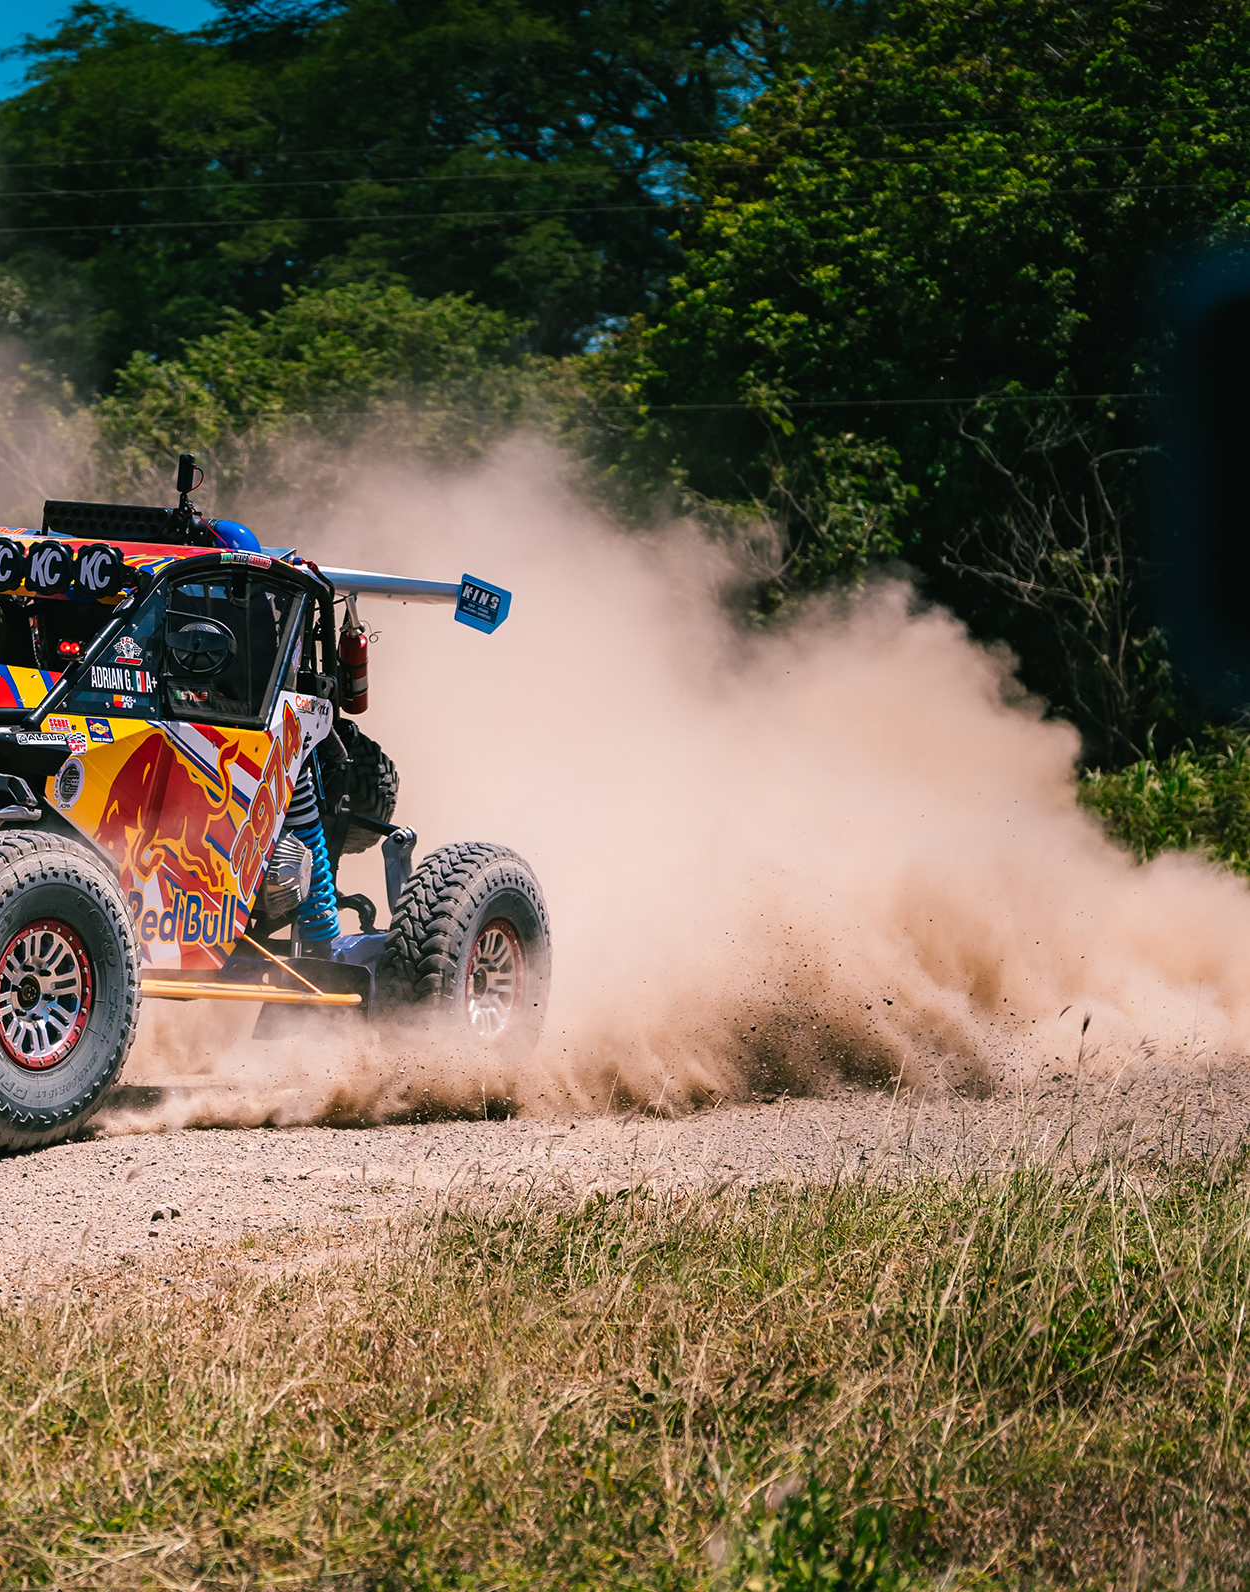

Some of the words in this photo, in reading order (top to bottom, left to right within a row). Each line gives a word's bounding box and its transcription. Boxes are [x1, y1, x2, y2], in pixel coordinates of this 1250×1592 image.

[30, 548, 62, 587] KC
[79, 551, 112, 591] KC
[462, 585, 500, 610] KING
[91, 666, 125, 691] ADRIAN
[124, 669, 135, 692] G.
[145, 671, 158, 693] A+
[230, 700, 302, 903] 2974
[128, 888, 181, 944] Red
[182, 890, 238, 945] Bull
